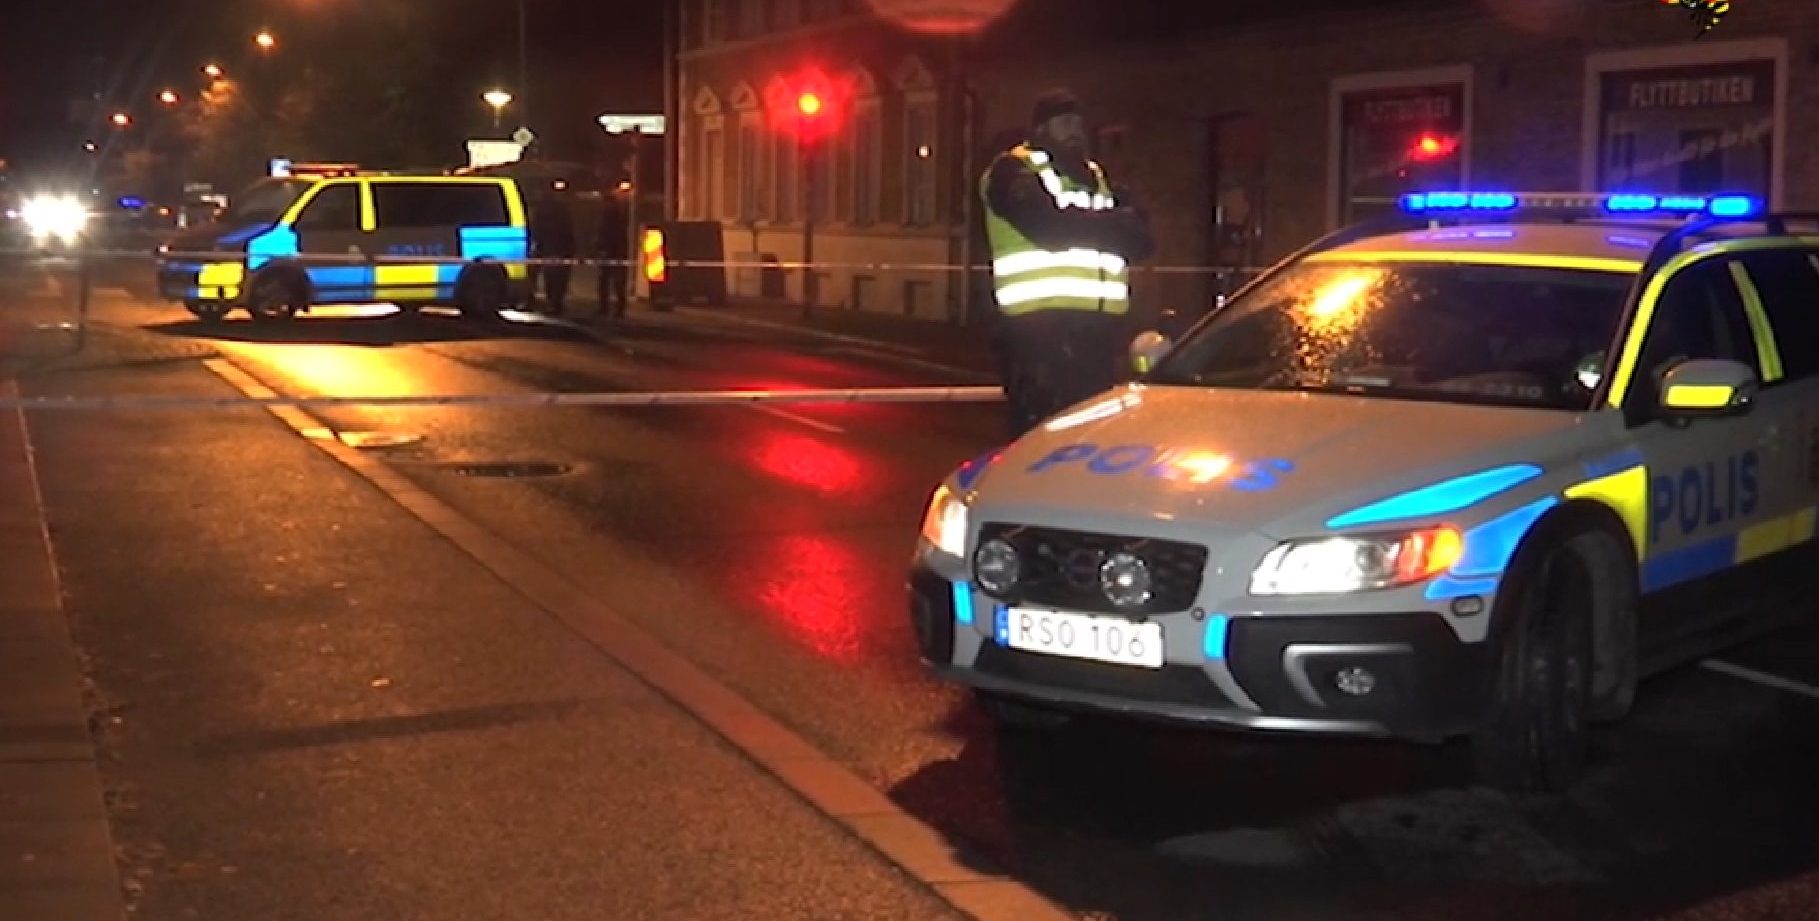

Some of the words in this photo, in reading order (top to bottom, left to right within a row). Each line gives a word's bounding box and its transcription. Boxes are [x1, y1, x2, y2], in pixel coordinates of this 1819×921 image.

[1629, 77, 1752, 107] FLYTTBUTIKEN
[1026, 442, 1294, 491] POLS
[1652, 451, 1759, 543] POLIS
[1091, 625, 1145, 657] 106
